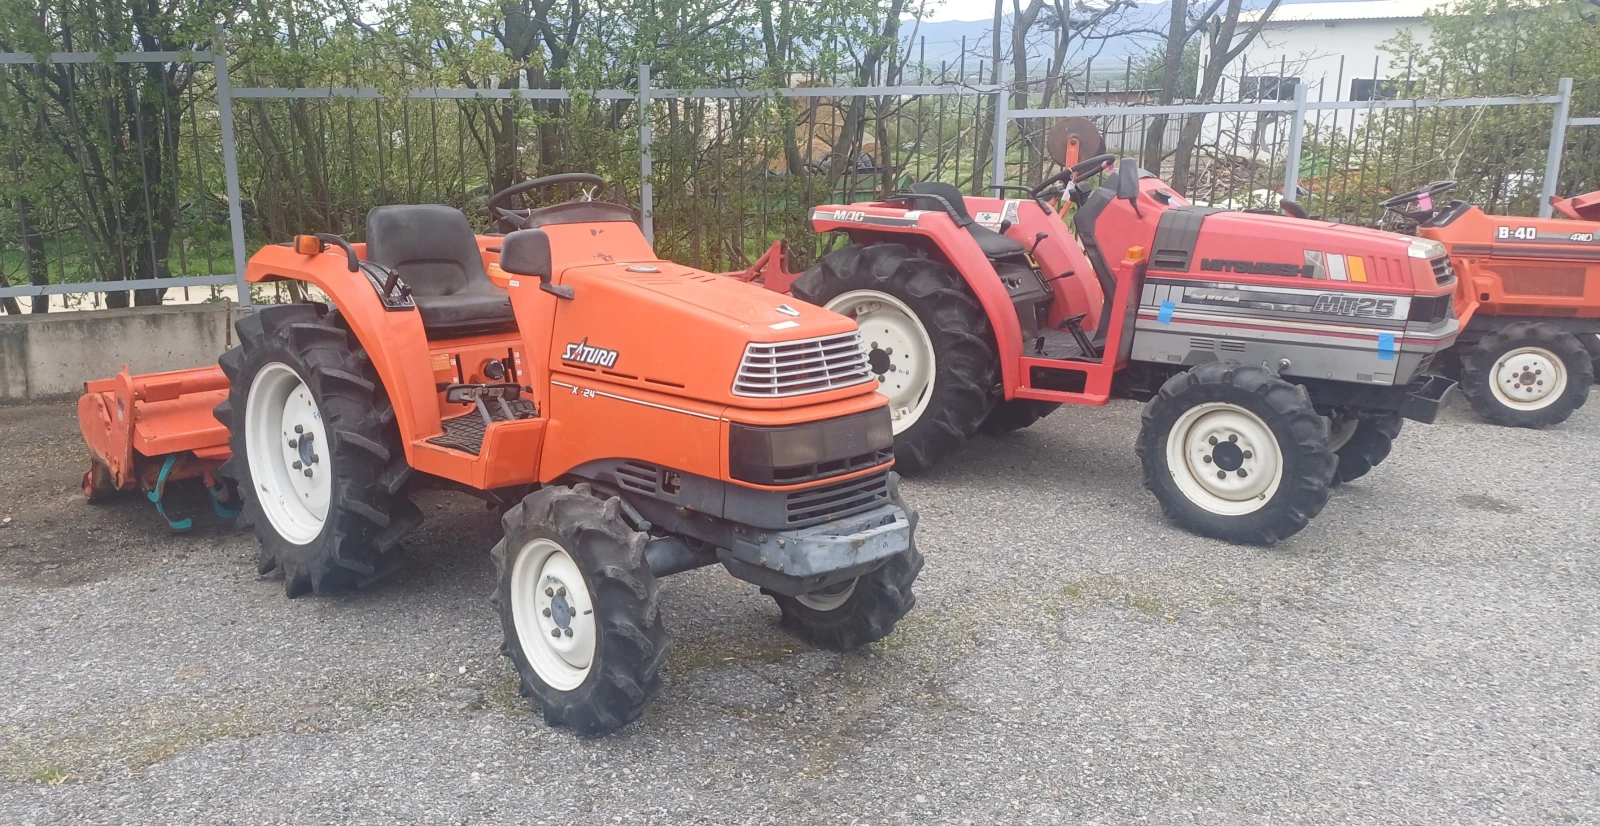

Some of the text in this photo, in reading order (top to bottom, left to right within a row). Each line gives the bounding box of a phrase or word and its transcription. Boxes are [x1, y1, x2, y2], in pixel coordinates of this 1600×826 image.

[833, 210, 865, 222] MAC
[1498, 226, 1537, 240] B-40
[1569, 232, 1594, 242] 4WD
[1200, 258, 1315, 278] MITSUBISHI
[1313, 294, 1397, 317] MT25
[561, 337, 620, 369] SATURN
